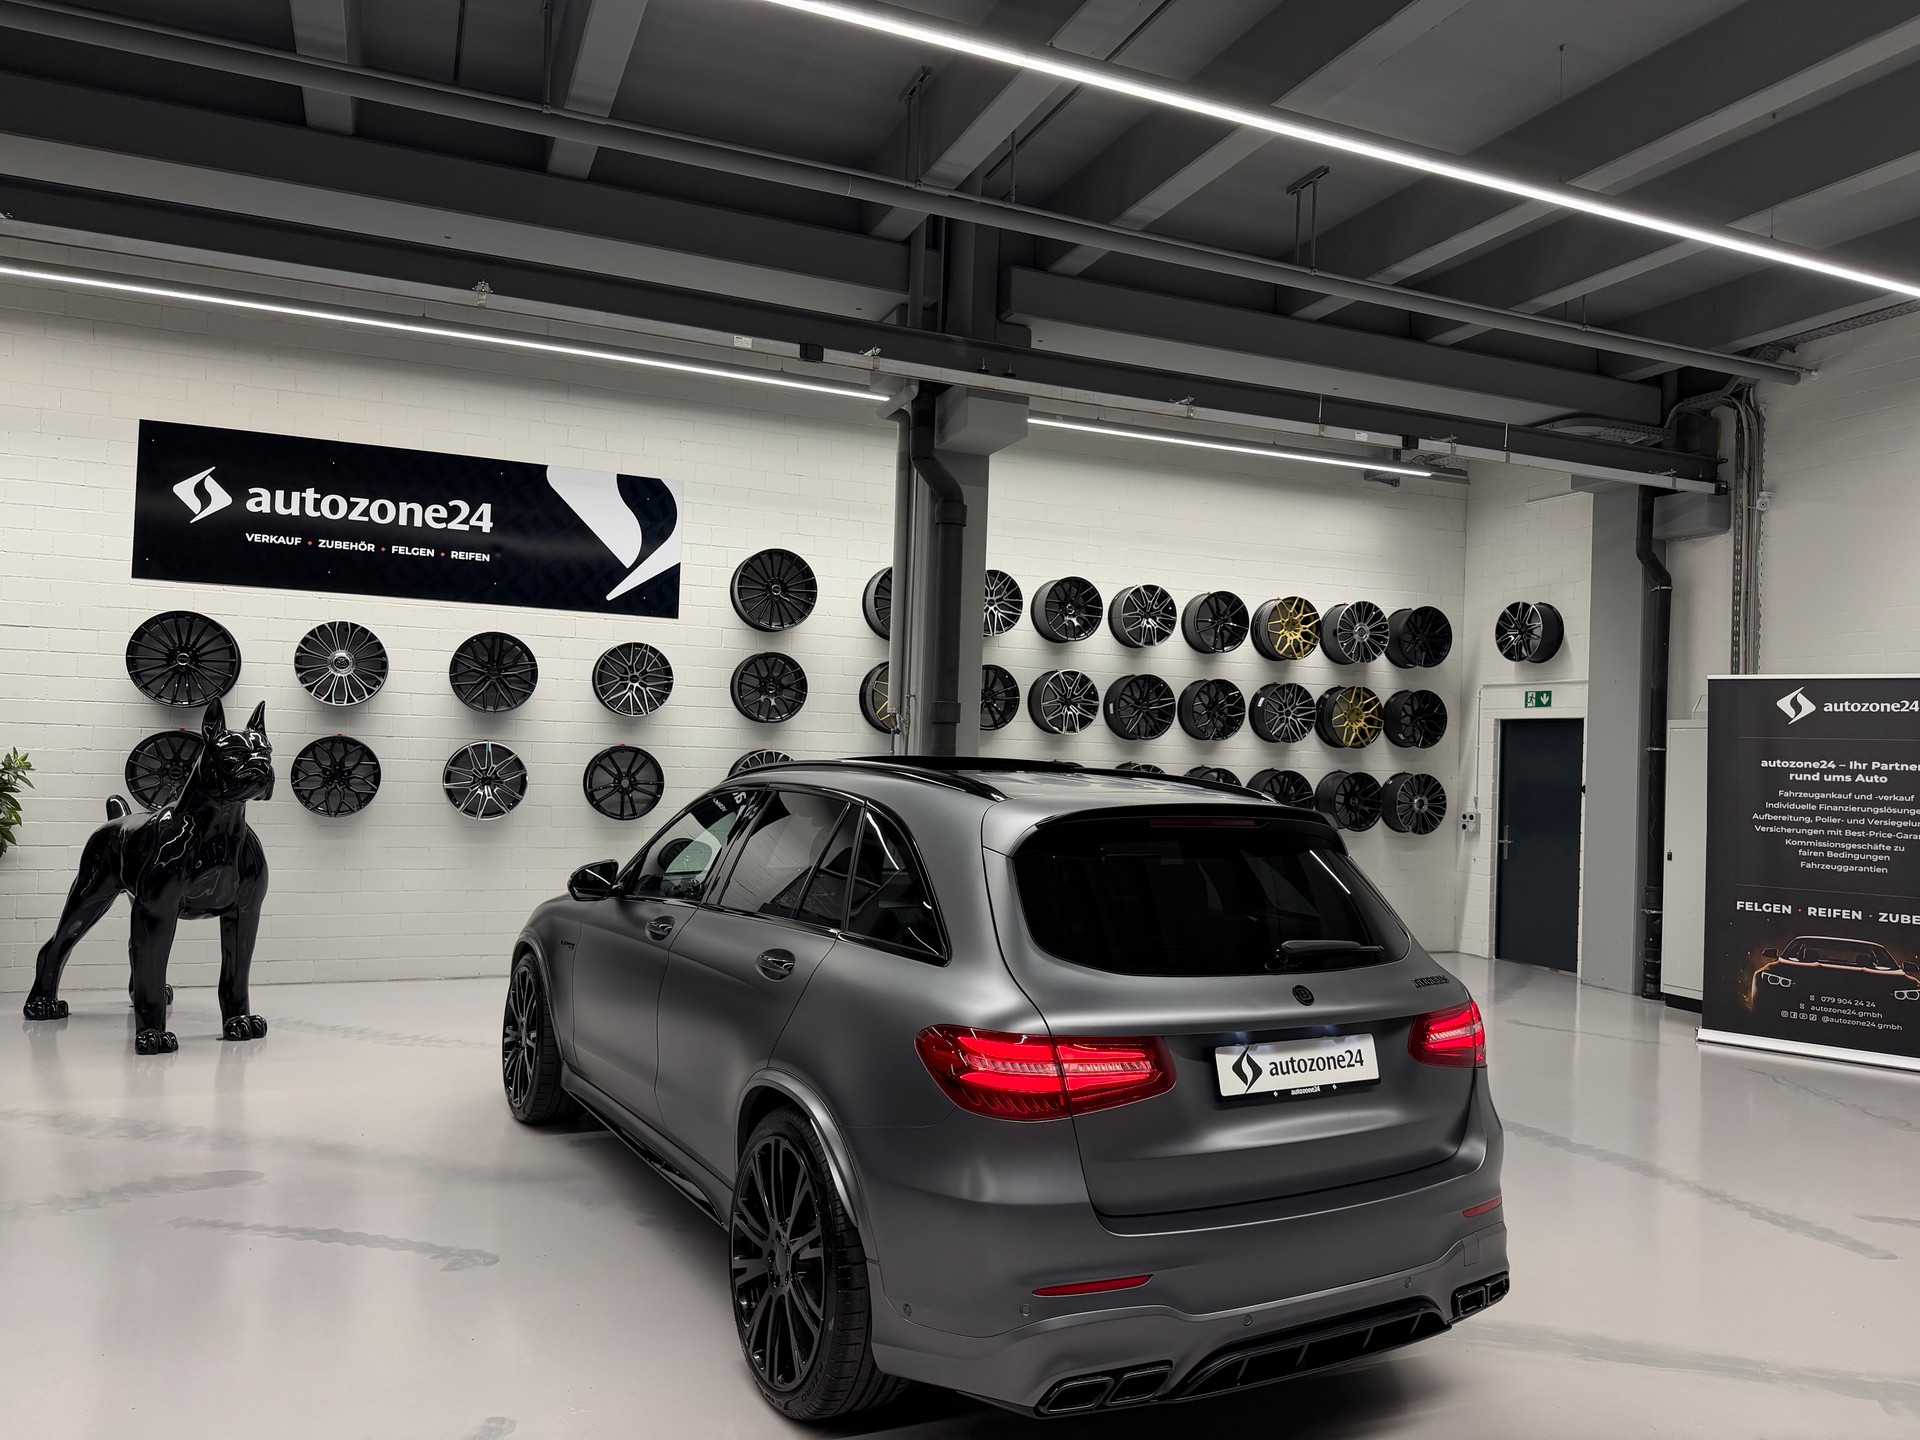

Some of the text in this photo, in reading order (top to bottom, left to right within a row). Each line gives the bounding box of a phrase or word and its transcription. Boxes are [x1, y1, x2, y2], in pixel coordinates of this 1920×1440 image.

[245, 487, 493, 533] autozone24
[245, 532, 490, 562] VERKAUF ZUBEHÖR FELGEN REIFEN
[1823, 699, 1919, 713] autozone24
[1760, 759, 1837, 769] autozone24
[1849, 760, 1868, 770] Ihr
[1789, 772, 1888, 783] rund ums Auto
[1778, 790, 1852, 800] Fahrzeugankauf
[1875, 794, 1915, 802] -verkauf
[1765, 801, 1817, 811] Individuelle
[1752, 813, 1813, 824] Aufbereitung,
[1815, 815, 1845, 824] Polier-
[1754, 825, 1920, 840] Versicherungen mit Best-Price-Gara
[1785, 838, 1892, 851] Kommissionsgeschäfte
[1798, 849, 1890, 862] fairen Bedingungen
[1800, 861, 1888, 874] Fahrzeuggarantien
[1736, 900, 1920, 925] FELGEN REIFEN ZUBE
[1820, 996, 1836, 1004] 079
[1836, 997, 1853, 1006] 904
[1854, 999, 1864, 1007] 24
[1810, 1005, 1883, 1019] autozone24.gmbh
[1821, 1015, 1903, 1031] @autozone24.gmbh
[1269, 1049, 1364, 1076] autozone24
[1291, 1085, 1321, 1096] autozone24
